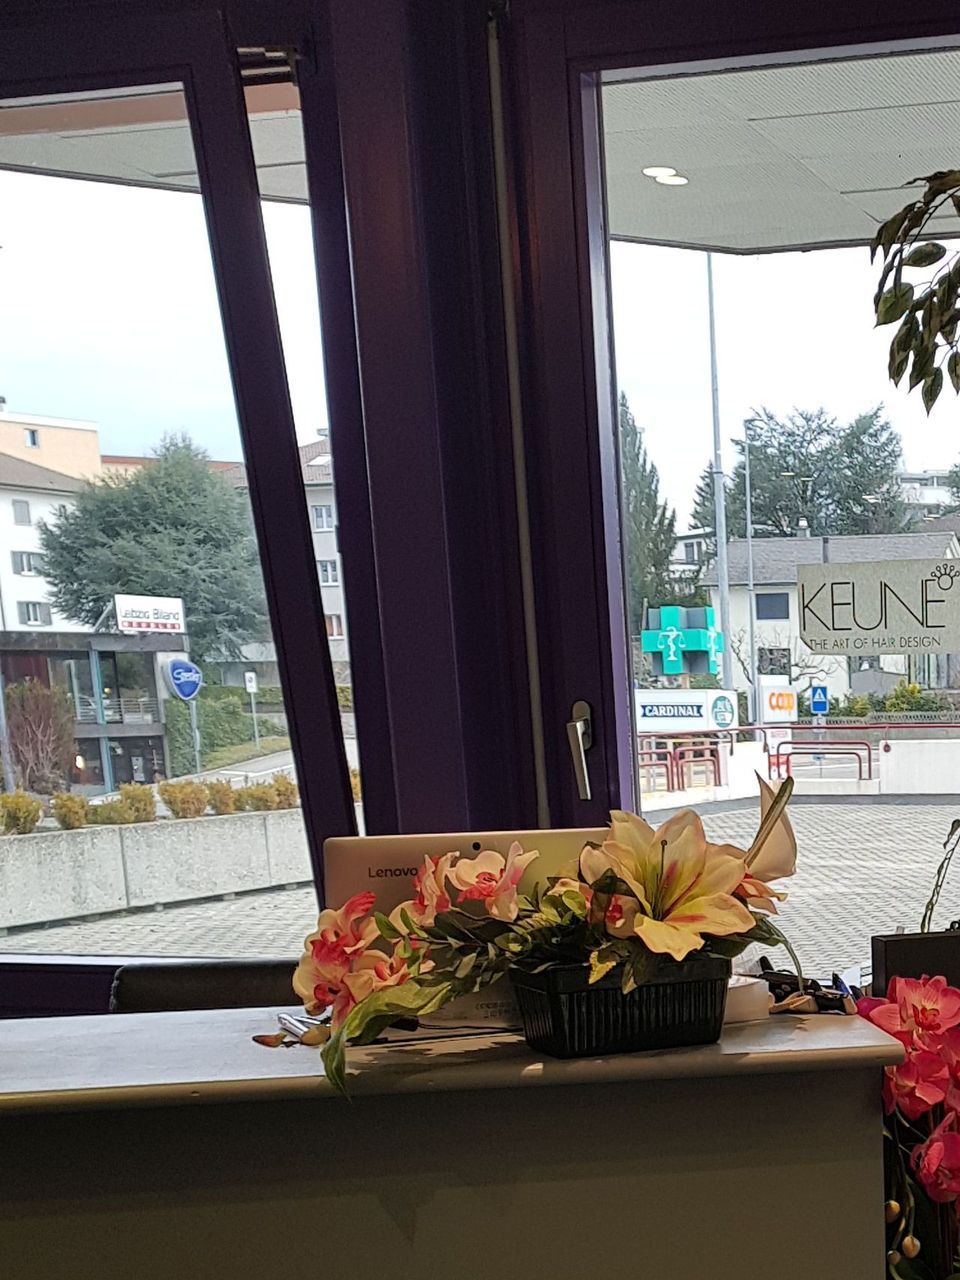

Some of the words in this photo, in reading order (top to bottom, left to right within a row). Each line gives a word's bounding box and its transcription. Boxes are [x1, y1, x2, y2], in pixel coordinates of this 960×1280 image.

[801, 579, 946, 632] KEUNE
[810, 638, 829, 650] THE
[832, 638, 850, 650] ART
[853, 637, 869, 649] OF
[872, 637, 896, 649] HAIR
[900, 636, 942, 649] DESIGN
[645, 704, 700, 717] CARDINAL
[368, 866, 419, 878] Lenovo
